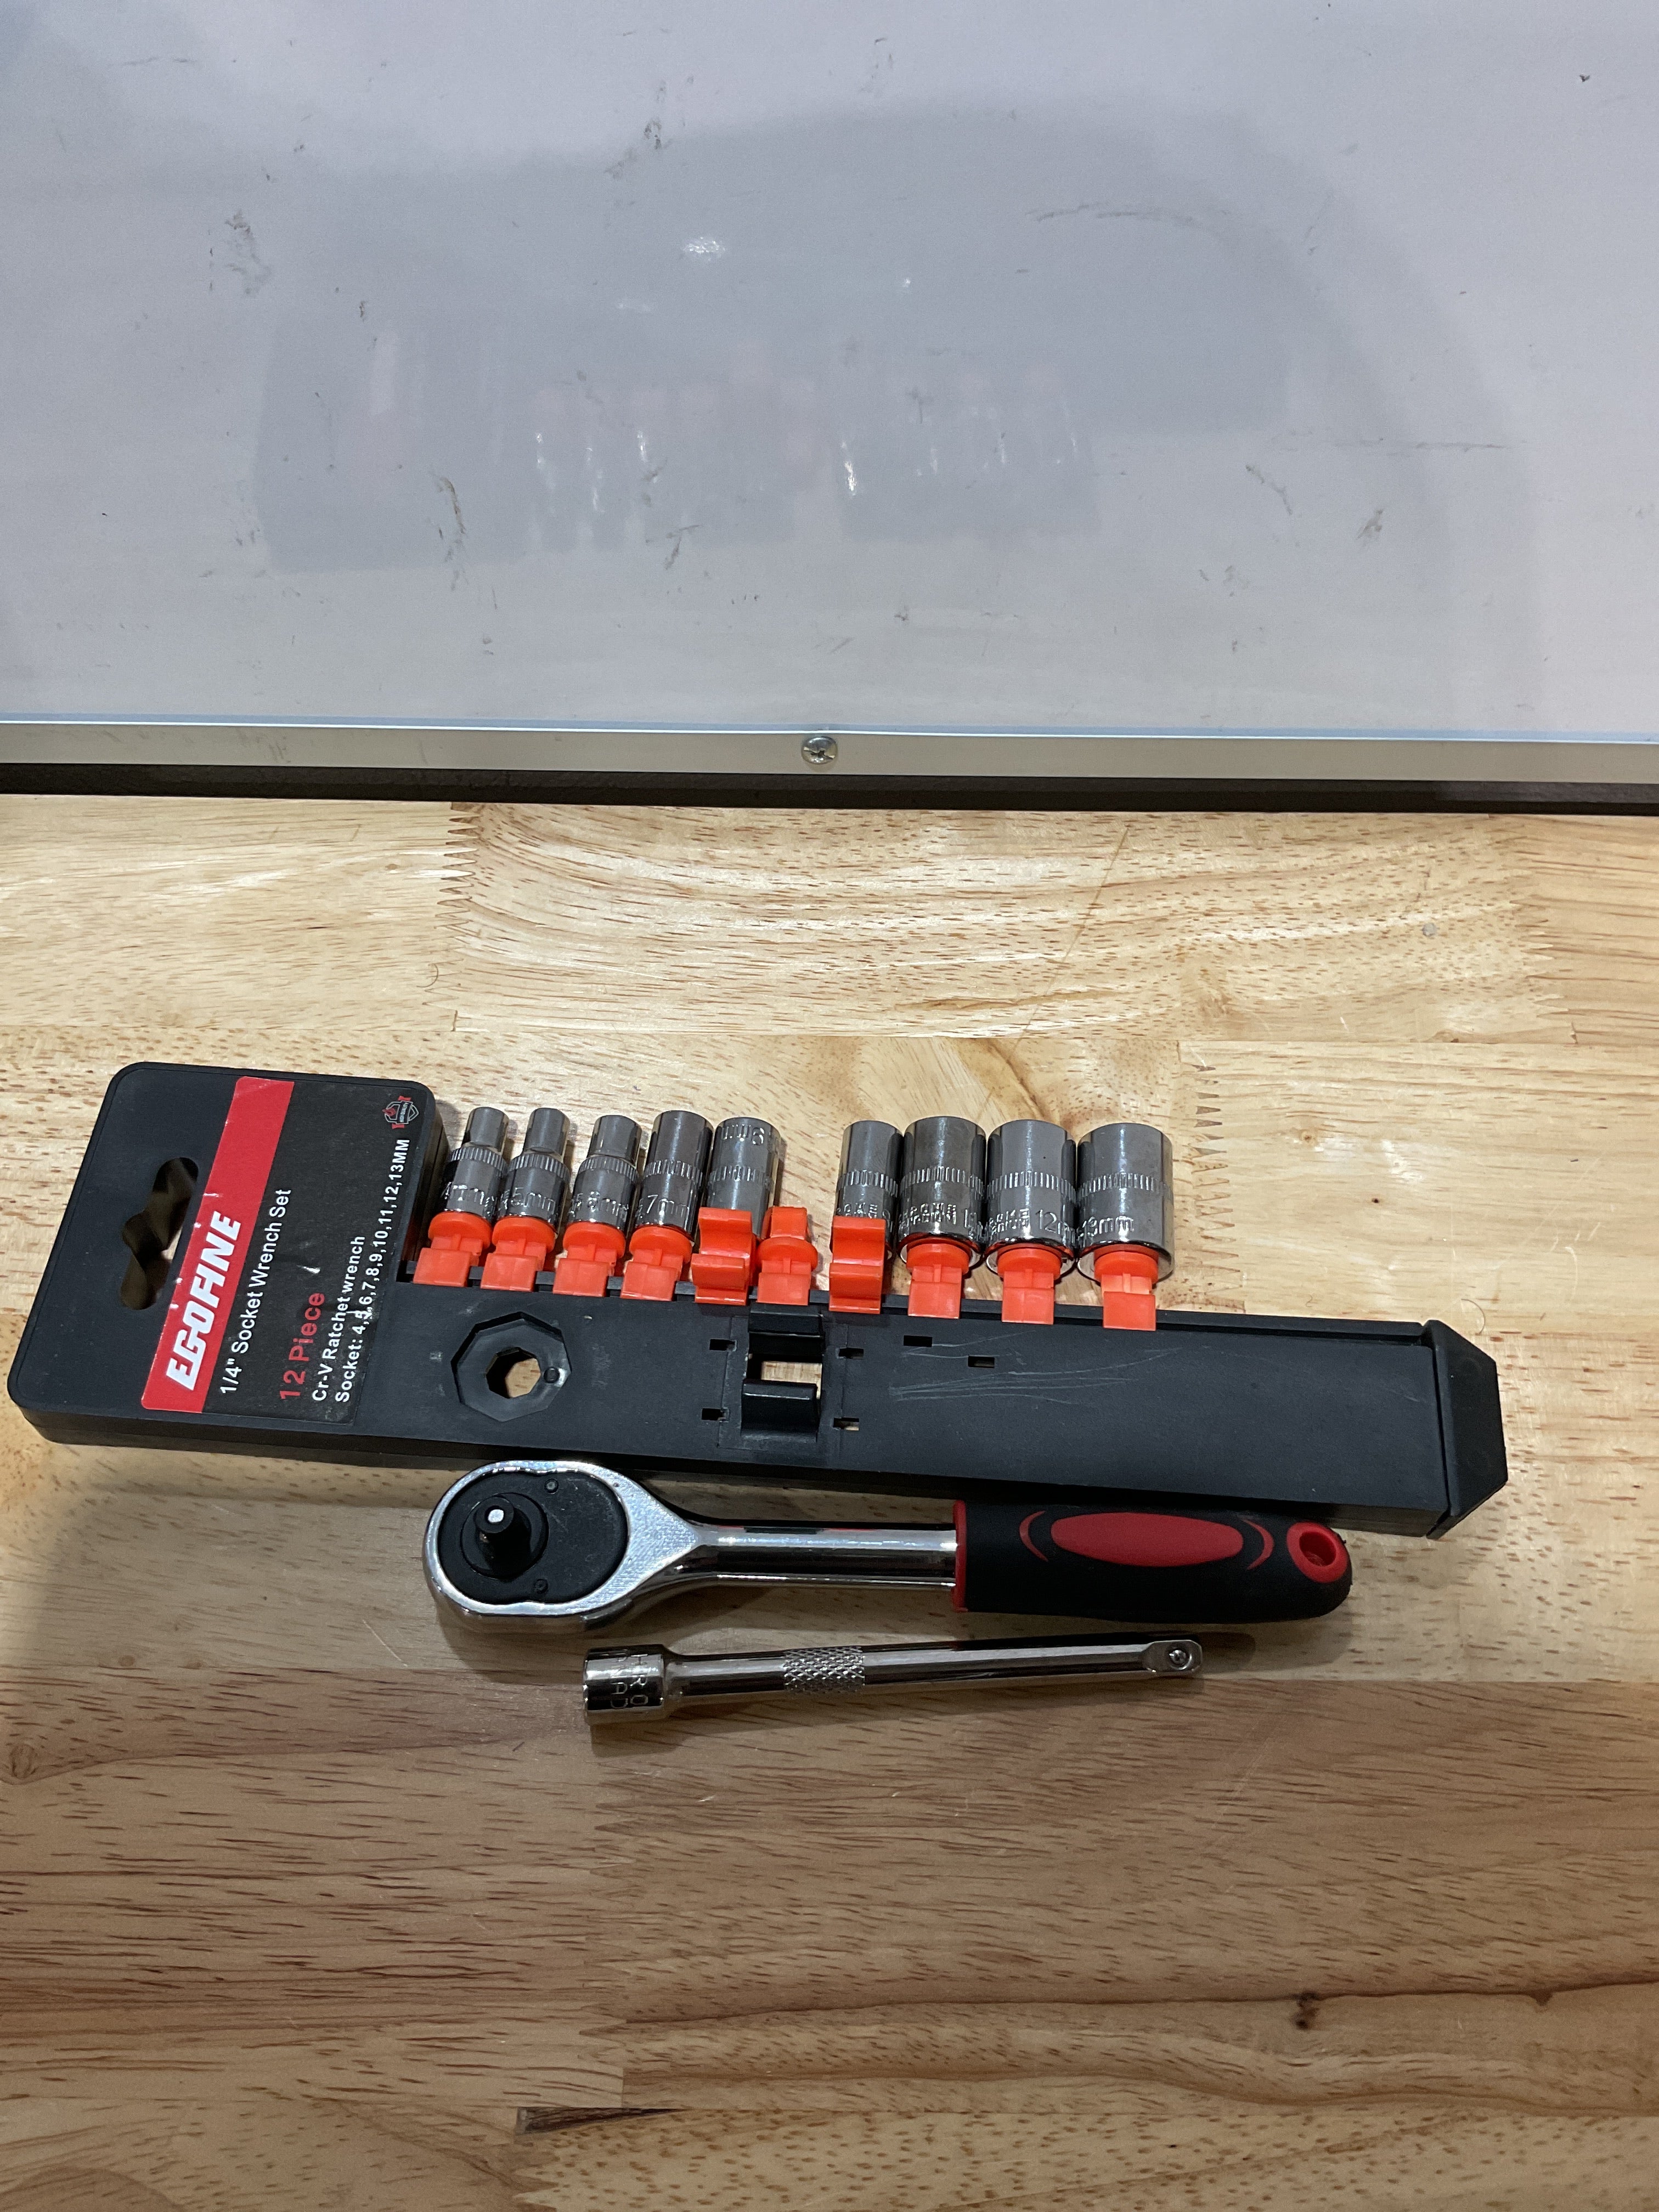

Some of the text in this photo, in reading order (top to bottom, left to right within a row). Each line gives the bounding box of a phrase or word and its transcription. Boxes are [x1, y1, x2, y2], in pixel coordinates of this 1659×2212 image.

[220, 1189, 291, 1393] 1/4" Socket Wrench Set
[280, 1293, 325, 1399] 12 Piece
[312, 1237, 365, 1401] Cr-V Ratchet wrench
[335, 1339, 364, 1402] Socket:
